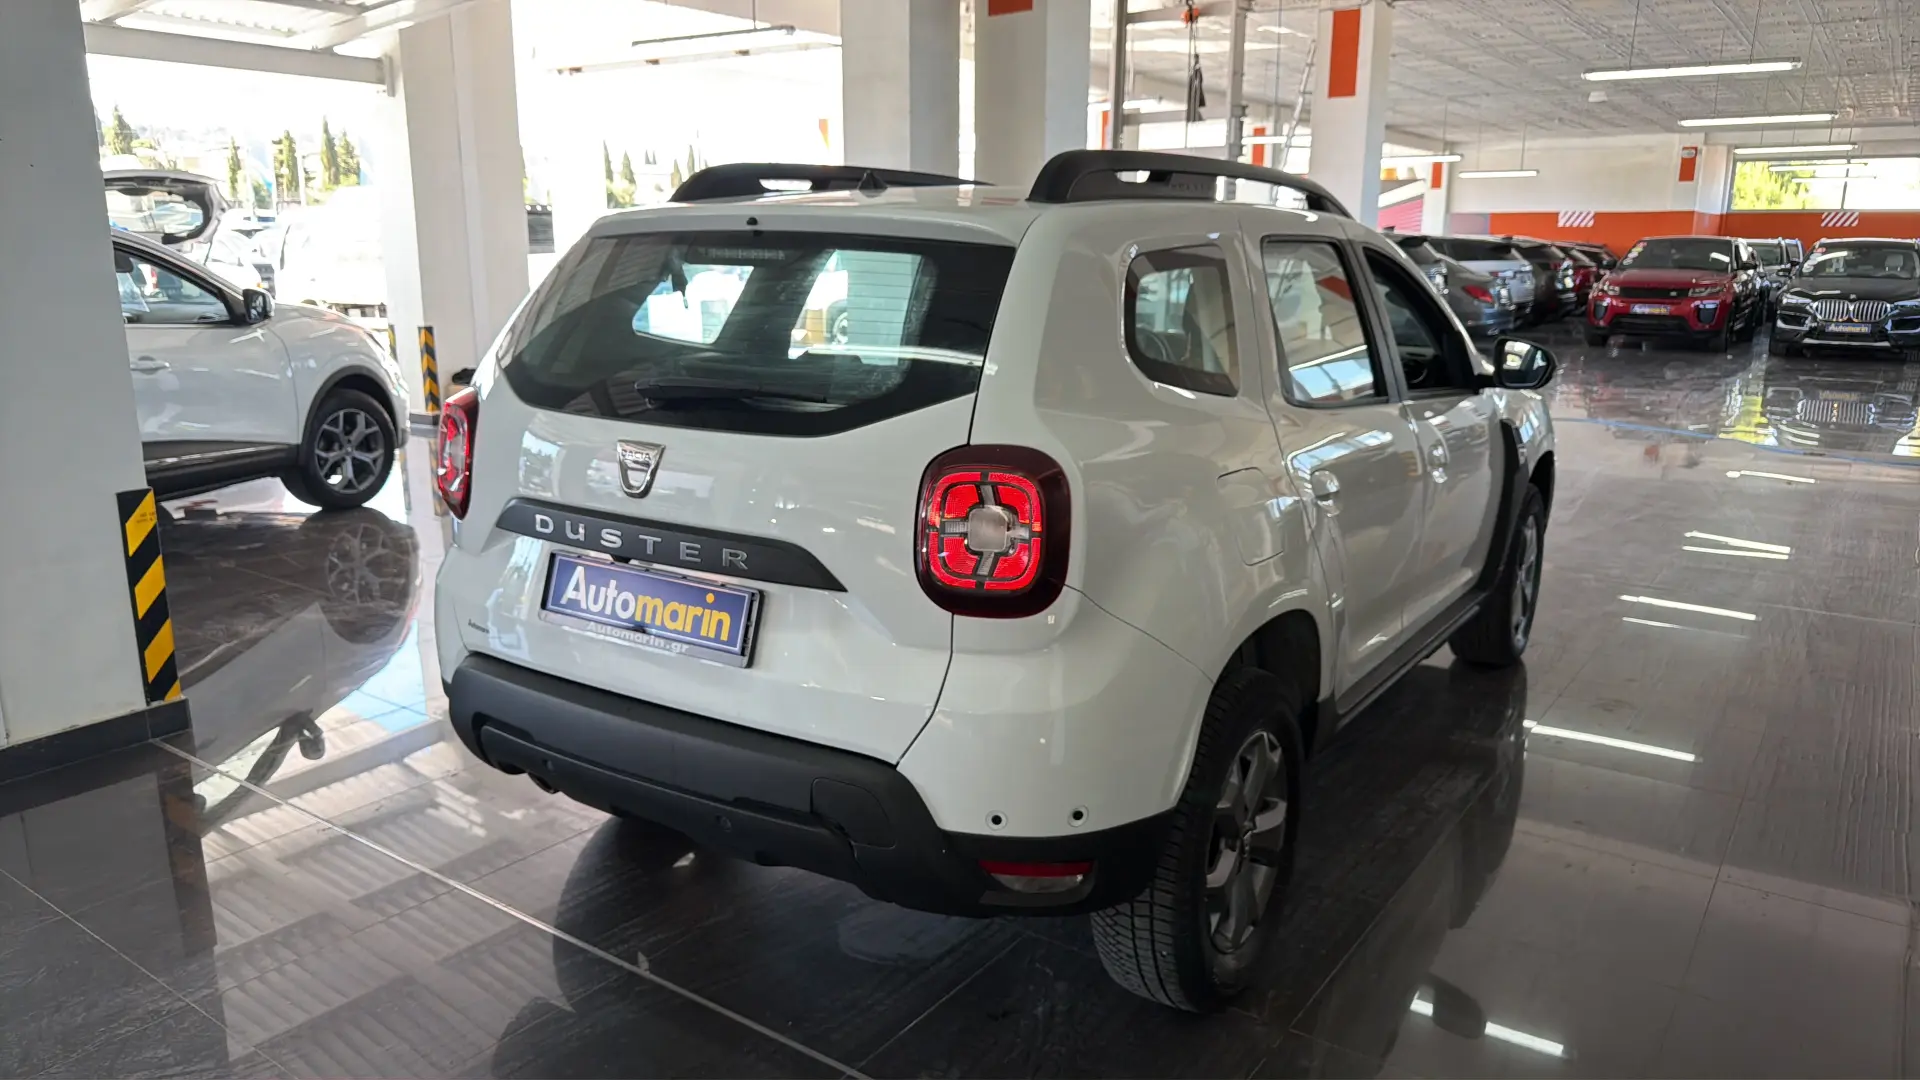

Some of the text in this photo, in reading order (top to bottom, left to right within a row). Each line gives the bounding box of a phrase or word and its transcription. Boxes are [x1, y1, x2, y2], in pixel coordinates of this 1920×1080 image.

[535, 513, 749, 570] DUSTER
[559, 564, 732, 642] Automarin
[586, 621, 690, 654] Automarin.gr
